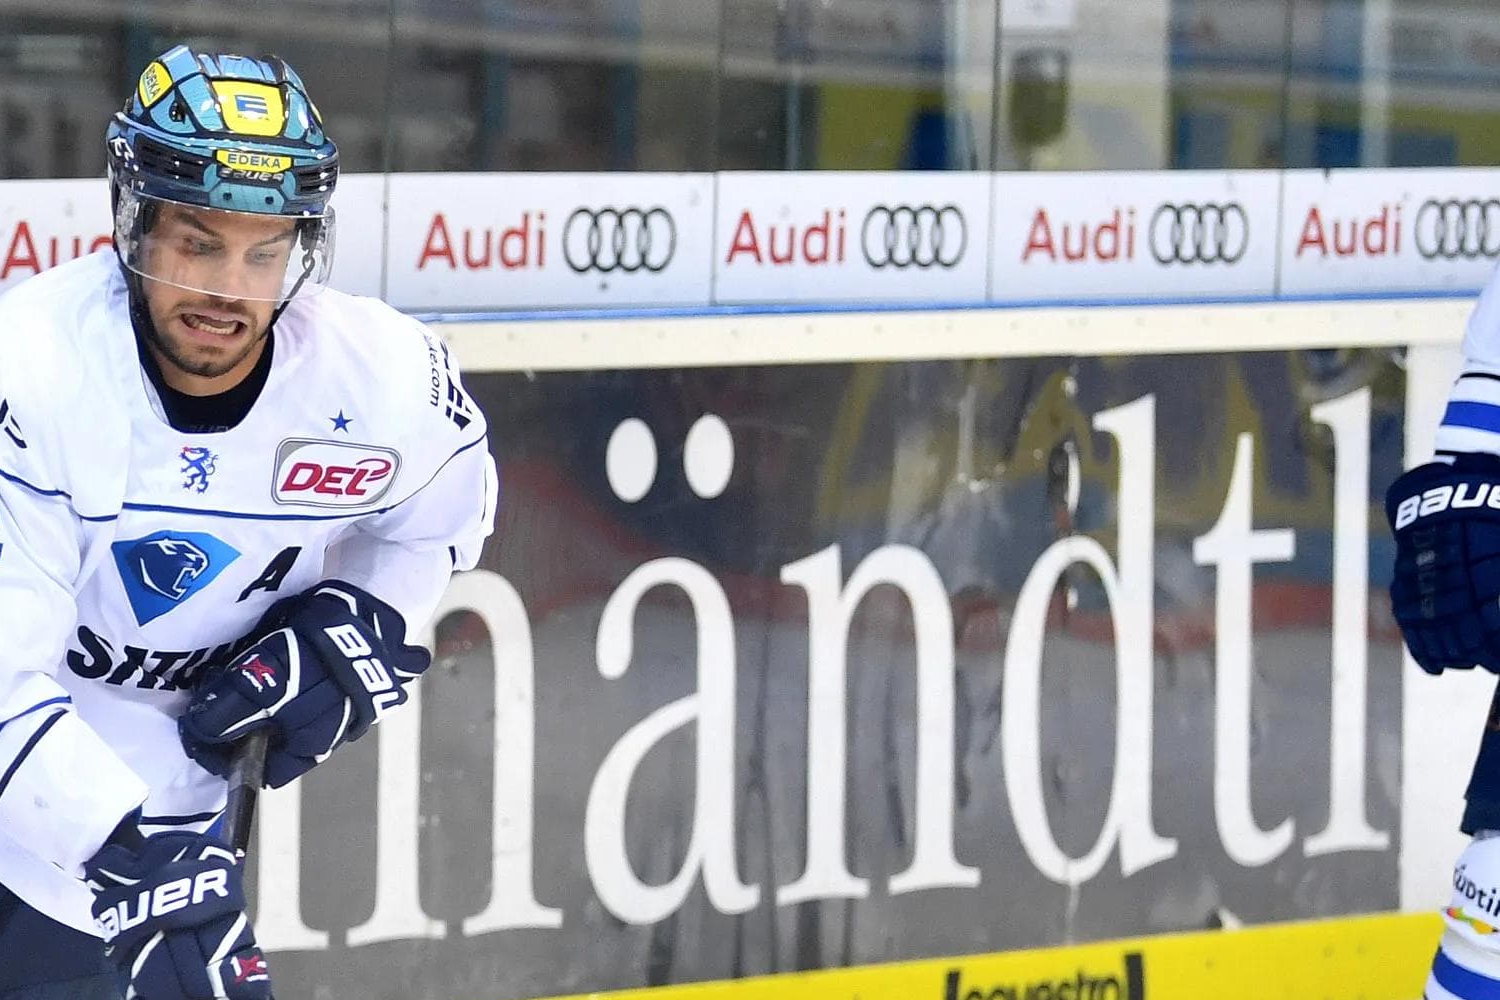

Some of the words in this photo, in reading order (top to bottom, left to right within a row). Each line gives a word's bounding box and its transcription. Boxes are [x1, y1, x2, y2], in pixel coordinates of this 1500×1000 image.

[227, 153, 282, 170] EDEKA
[418, 212, 546, 271] Audi
[725, 210, 846, 266] Audi
[1021, 209, 1135, 264] Audi
[1296, 205, 1401, 257] Audi
[280, 457, 393, 497] DEL
[235, 545, 302, 603] A
